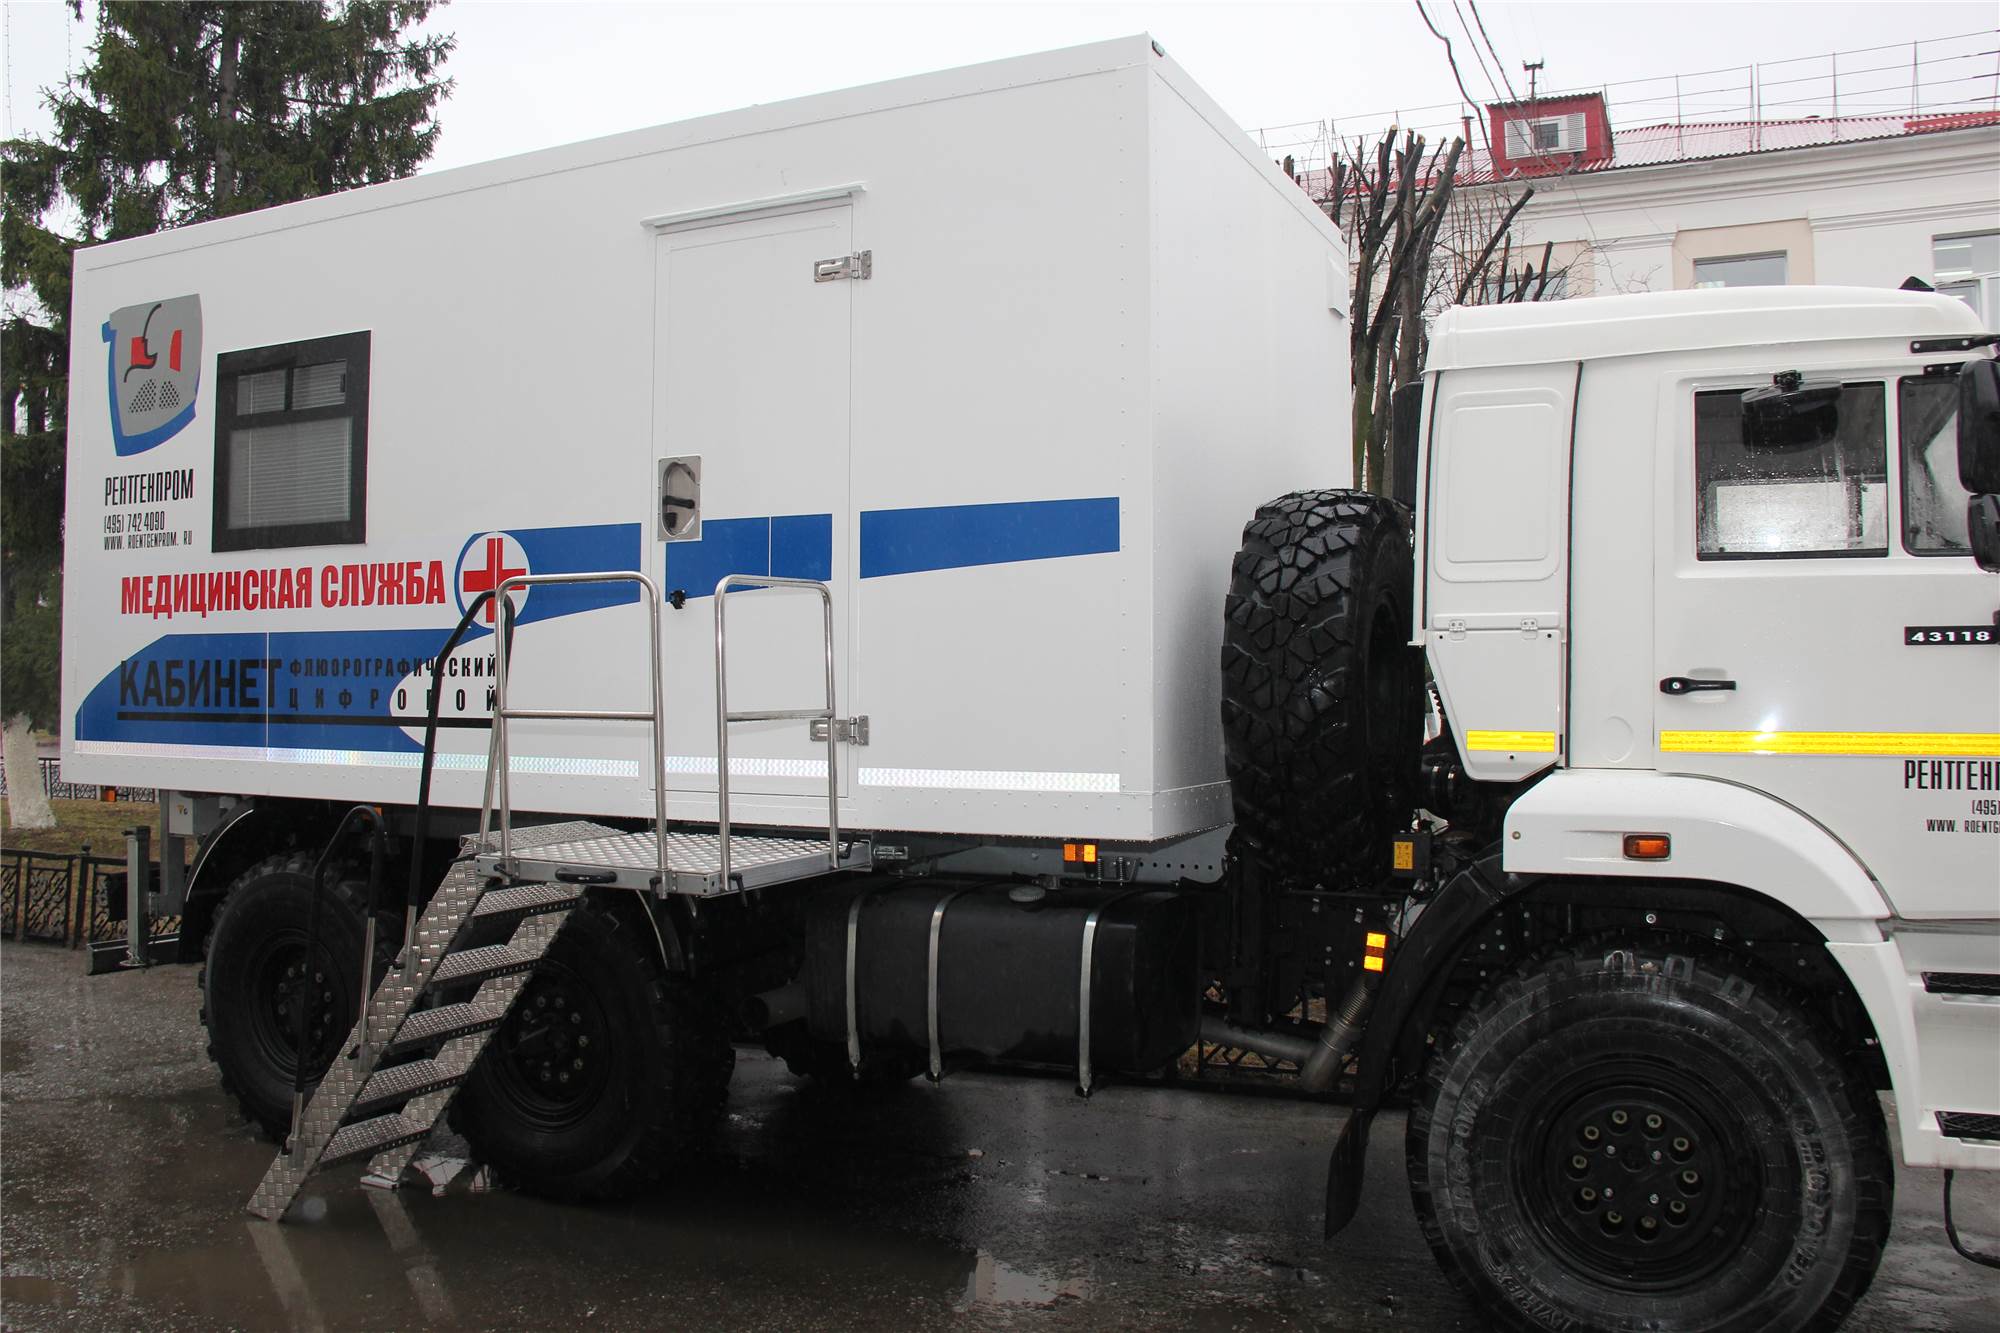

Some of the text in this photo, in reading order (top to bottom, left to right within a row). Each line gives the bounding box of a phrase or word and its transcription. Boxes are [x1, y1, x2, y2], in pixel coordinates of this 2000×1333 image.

[104, 468, 194, 507] РЕНТГЕНПРОМ
[103, 511, 165, 534] (495) 742 4090
[121, 560, 446, 620] МЕДИЦИНСКАЯ СЛУЖБА
[1910, 631, 1991, 642] 43118
[290, 653, 497, 677] ФЛЮОРОГРАФИЧСКИЙ
[119, 658, 283, 709] КАБИНЕТ
[1964, 820, 2000, 834] ROENTG
